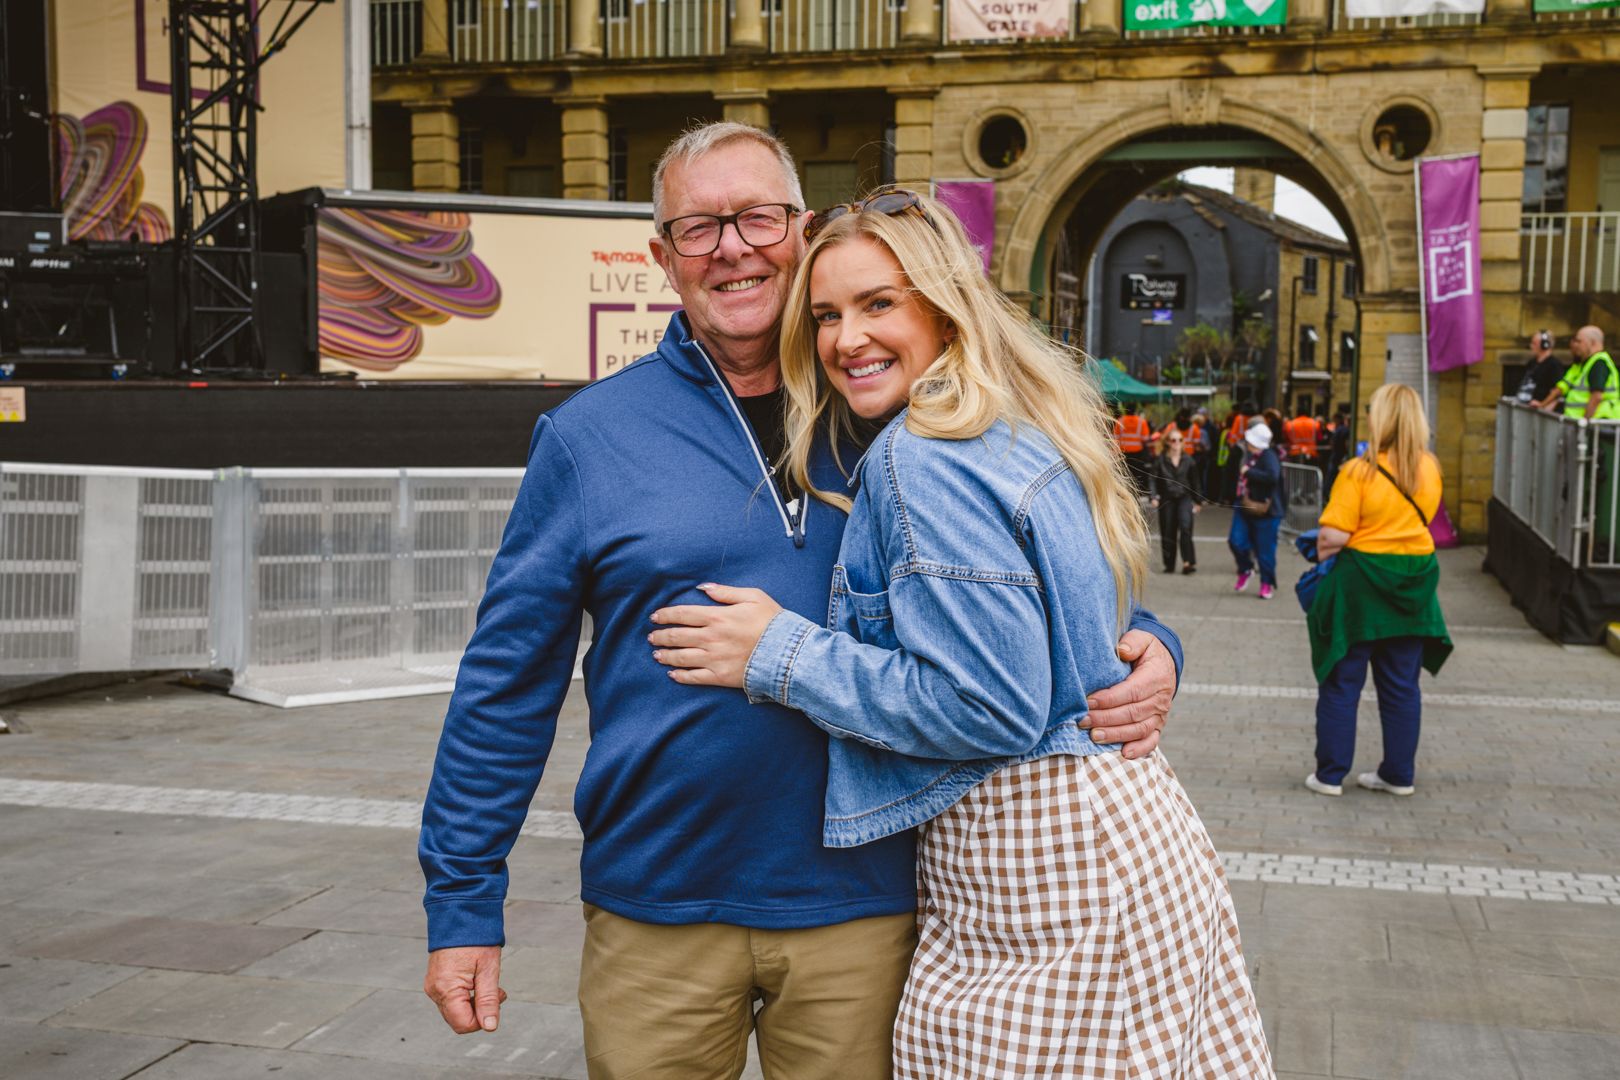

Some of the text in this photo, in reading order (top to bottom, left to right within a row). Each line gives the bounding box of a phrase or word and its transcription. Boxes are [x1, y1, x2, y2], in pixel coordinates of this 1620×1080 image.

[980, 3, 1038, 15] SOUTH
[1135, 0, 1178, 20] exit
[986, 20, 1030, 33] GATE
[590, 273, 648, 293] LIVE
[620, 329, 663, 345] THE
